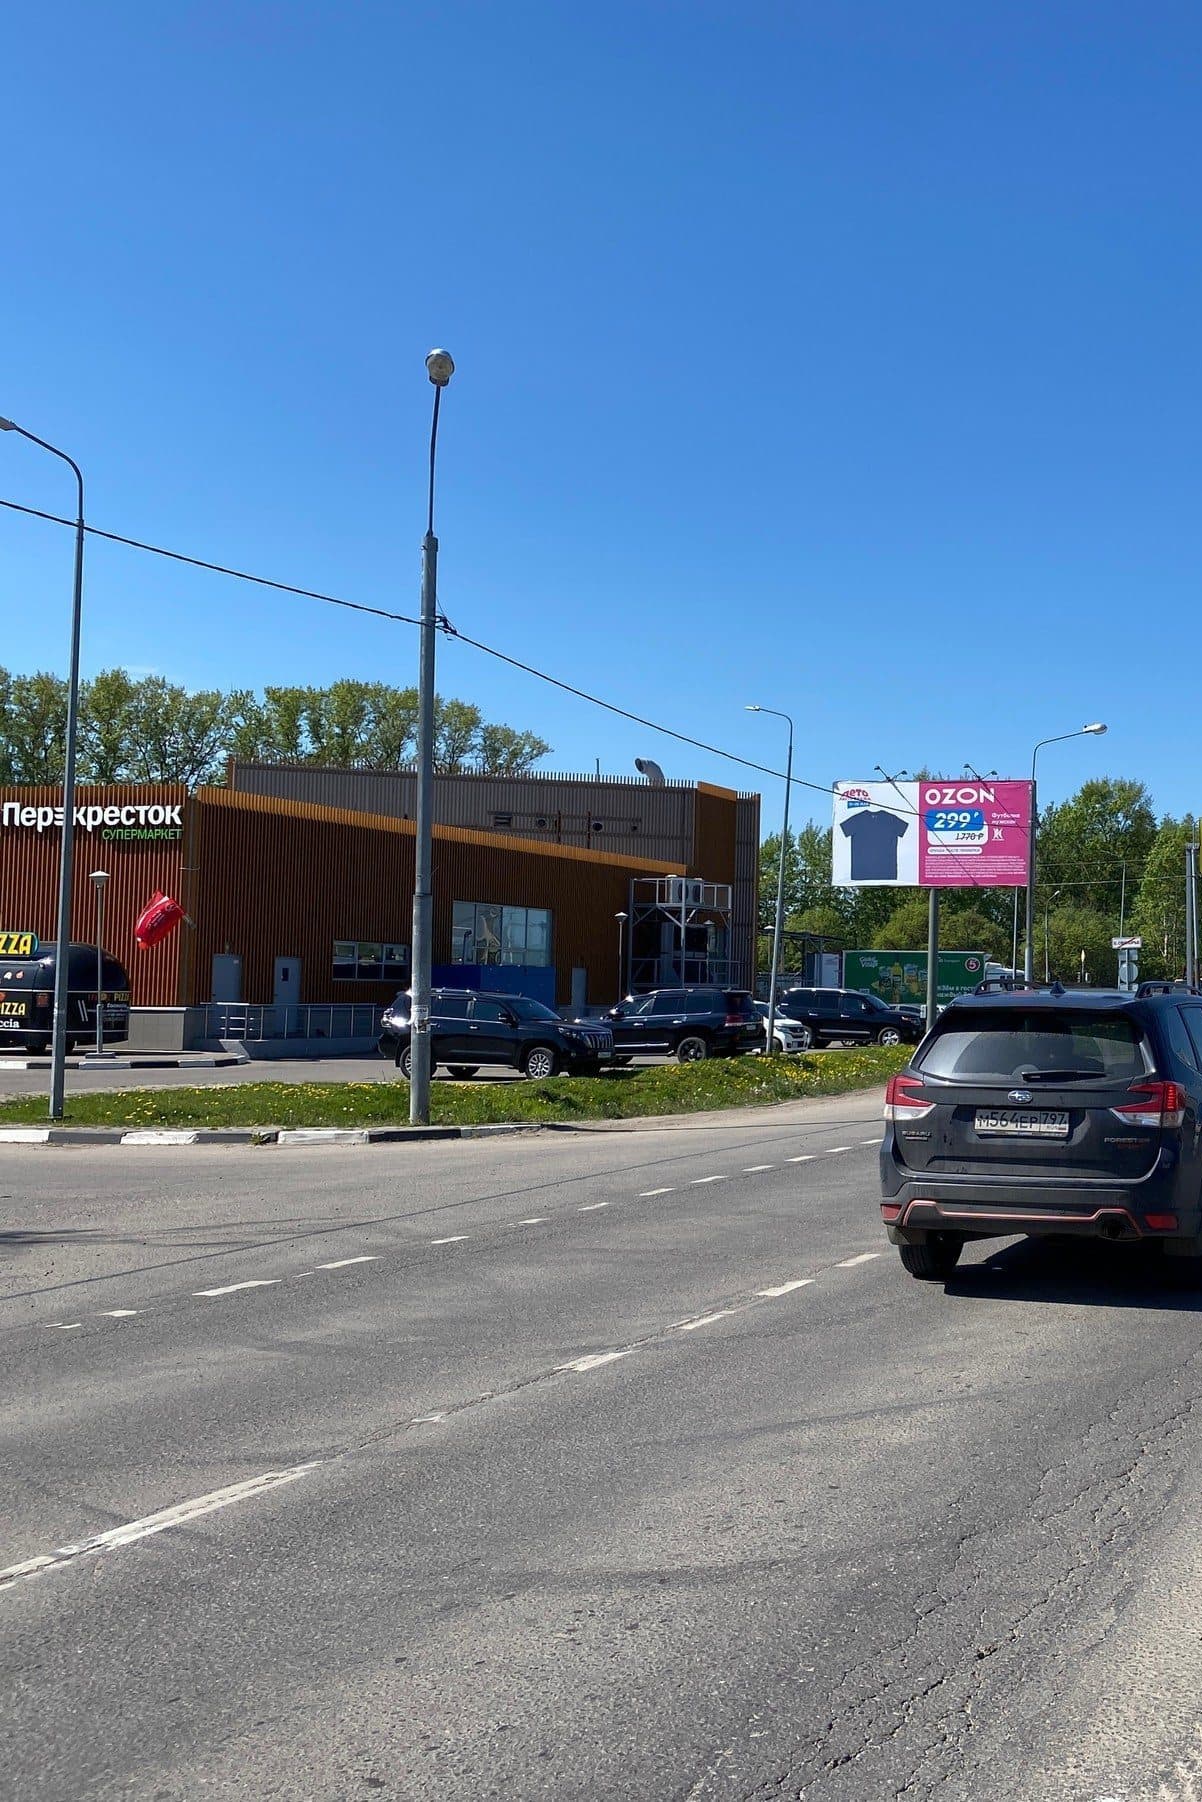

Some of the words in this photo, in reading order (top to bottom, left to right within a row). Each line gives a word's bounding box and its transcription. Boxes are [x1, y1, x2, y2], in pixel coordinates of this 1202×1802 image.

[925, 788, 995, 805] OZON
[934, 812, 971, 828] 299
[102, 828, 182, 840] СУПЕРМАРКЕТ
